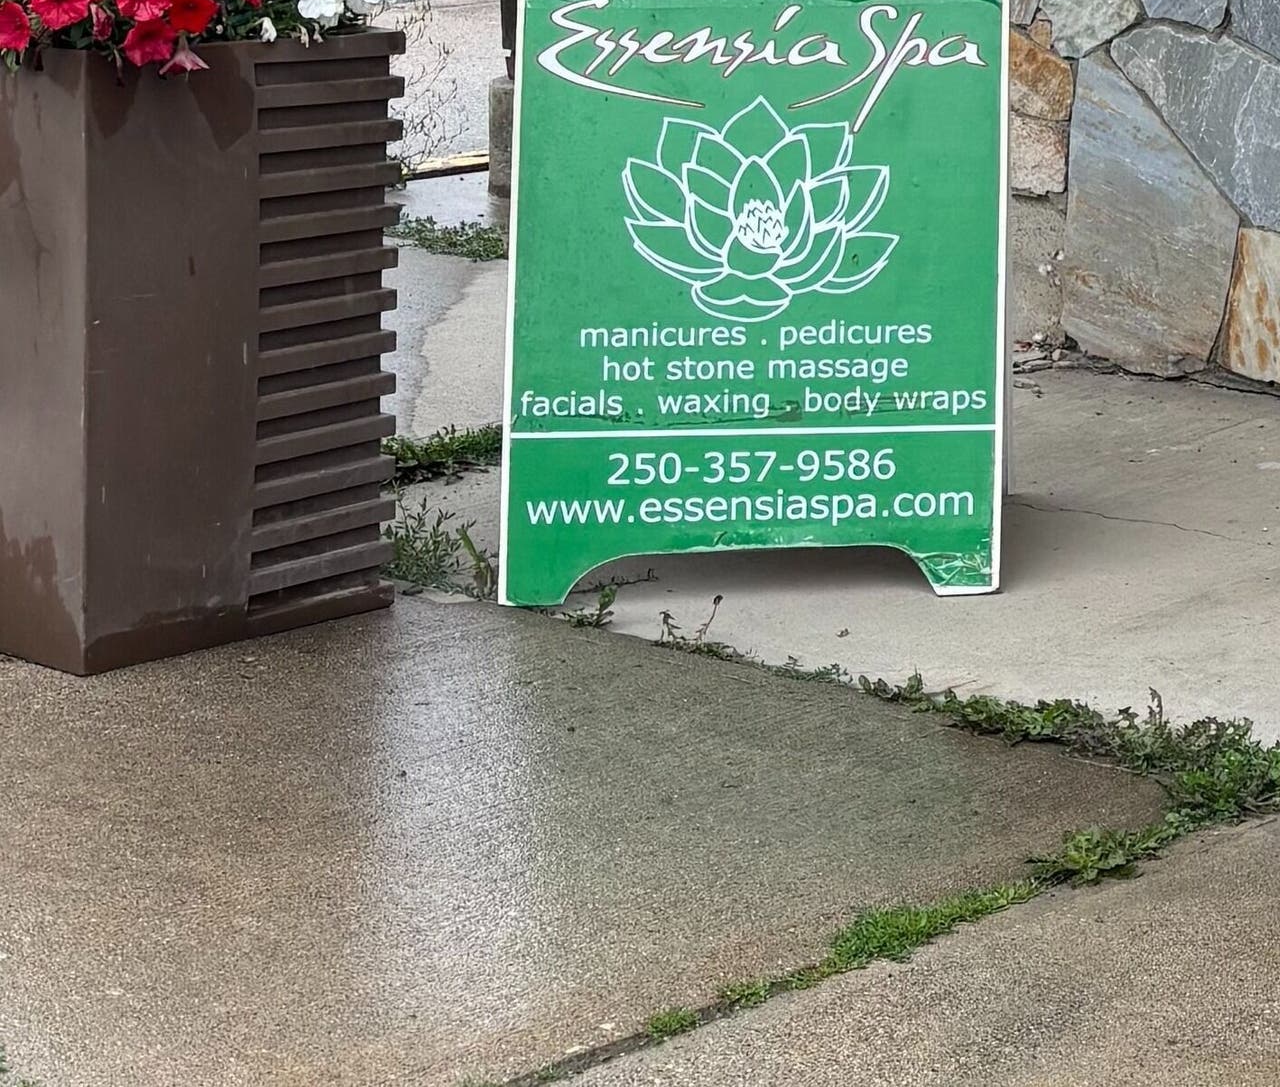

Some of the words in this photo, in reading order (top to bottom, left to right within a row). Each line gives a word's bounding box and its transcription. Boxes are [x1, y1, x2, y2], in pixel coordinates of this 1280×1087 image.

[788, 4, 989, 135] Spa
[580, 321, 747, 347] manicures
[779, 319, 932, 351] pedicures
[603, 355, 655, 381] hot
[666, 356, 755, 381] stone
[768, 358, 909, 383] massage
[521, 389, 623, 416] facials
[657, 388, 770, 419] waxing
[804, 385, 881, 417] body
[893, 388, 987, 415] wraps
[607, 448, 897, 485] 250-357-9586
[526, 489, 974, 526] www.essensiaspa.com
